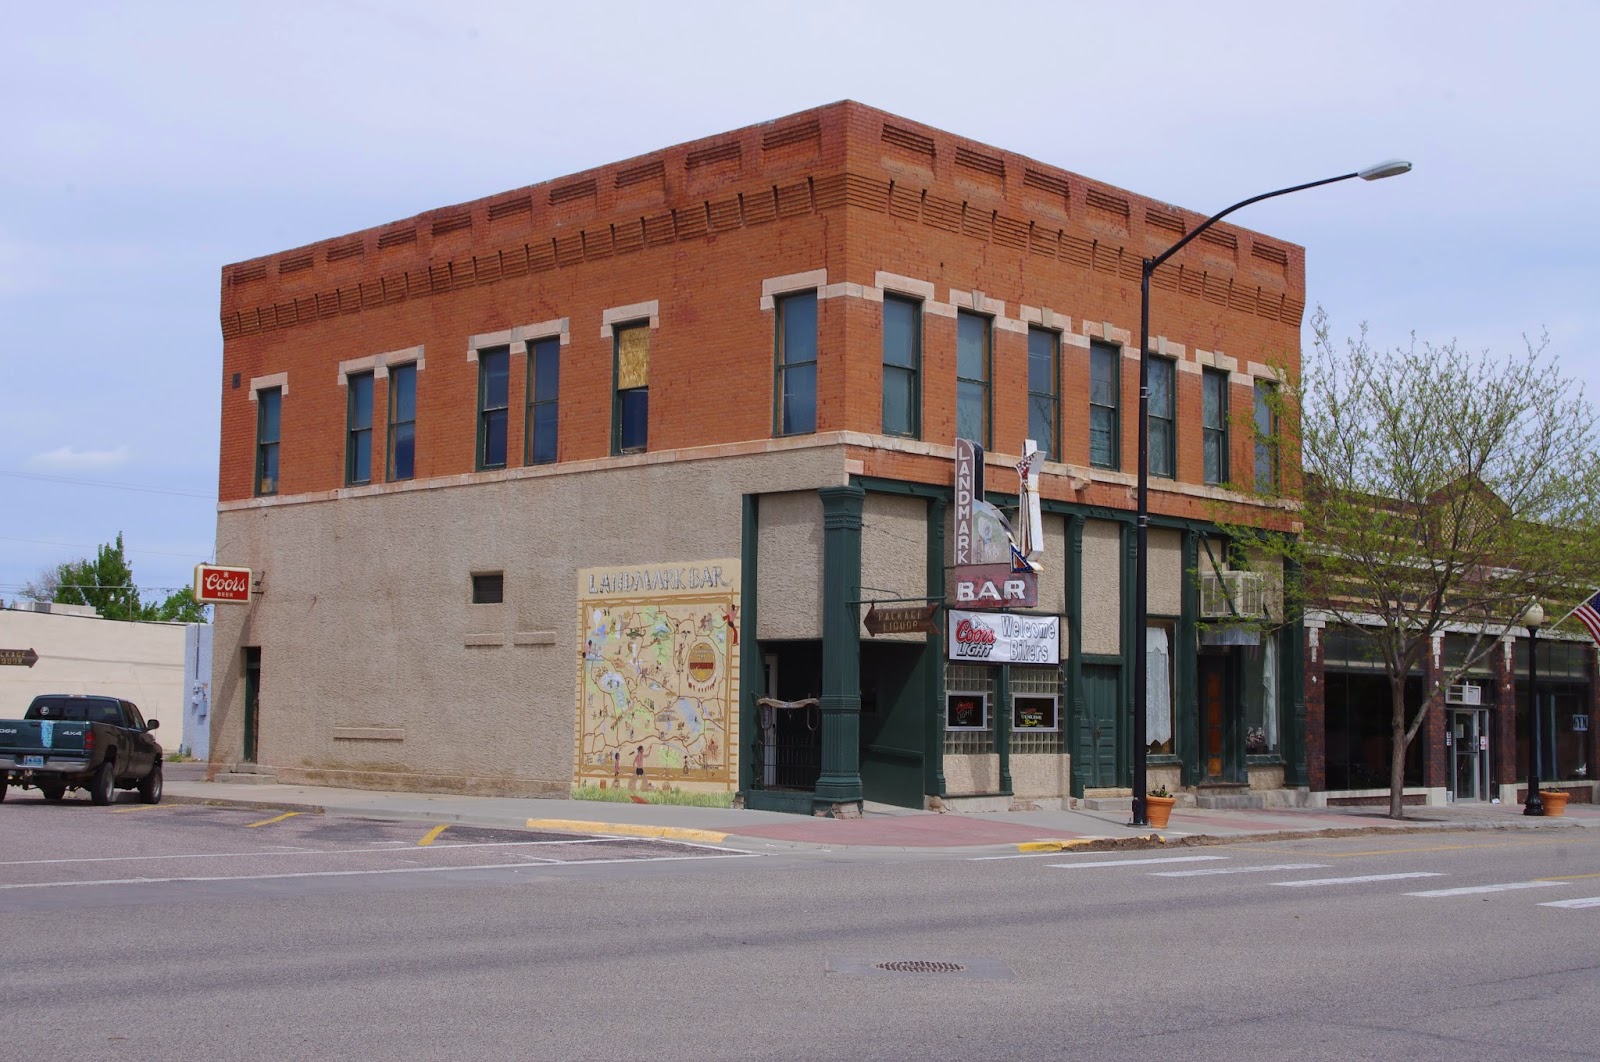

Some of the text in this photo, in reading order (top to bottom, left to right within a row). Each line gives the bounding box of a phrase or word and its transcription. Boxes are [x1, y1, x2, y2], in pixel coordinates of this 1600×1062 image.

[957, 446, 971, 564] LANDMARK
[205, 573, 246, 591] Coors
[689, 566, 733, 588] BAR
[957, 580, 1025, 602] BAR
[878, 609, 923, 621] PACKAGE
[883, 620, 919, 631] LIQUOR
[956, 618, 997, 645] Coors
[1001, 615, 1056, 639] Welcome
[0, 650, 26, 659] CKAGE
[956, 643, 993, 658] LIGHT
[1010, 640, 1049, 662] Bikers
[1, 657, 23, 665] QUOR
